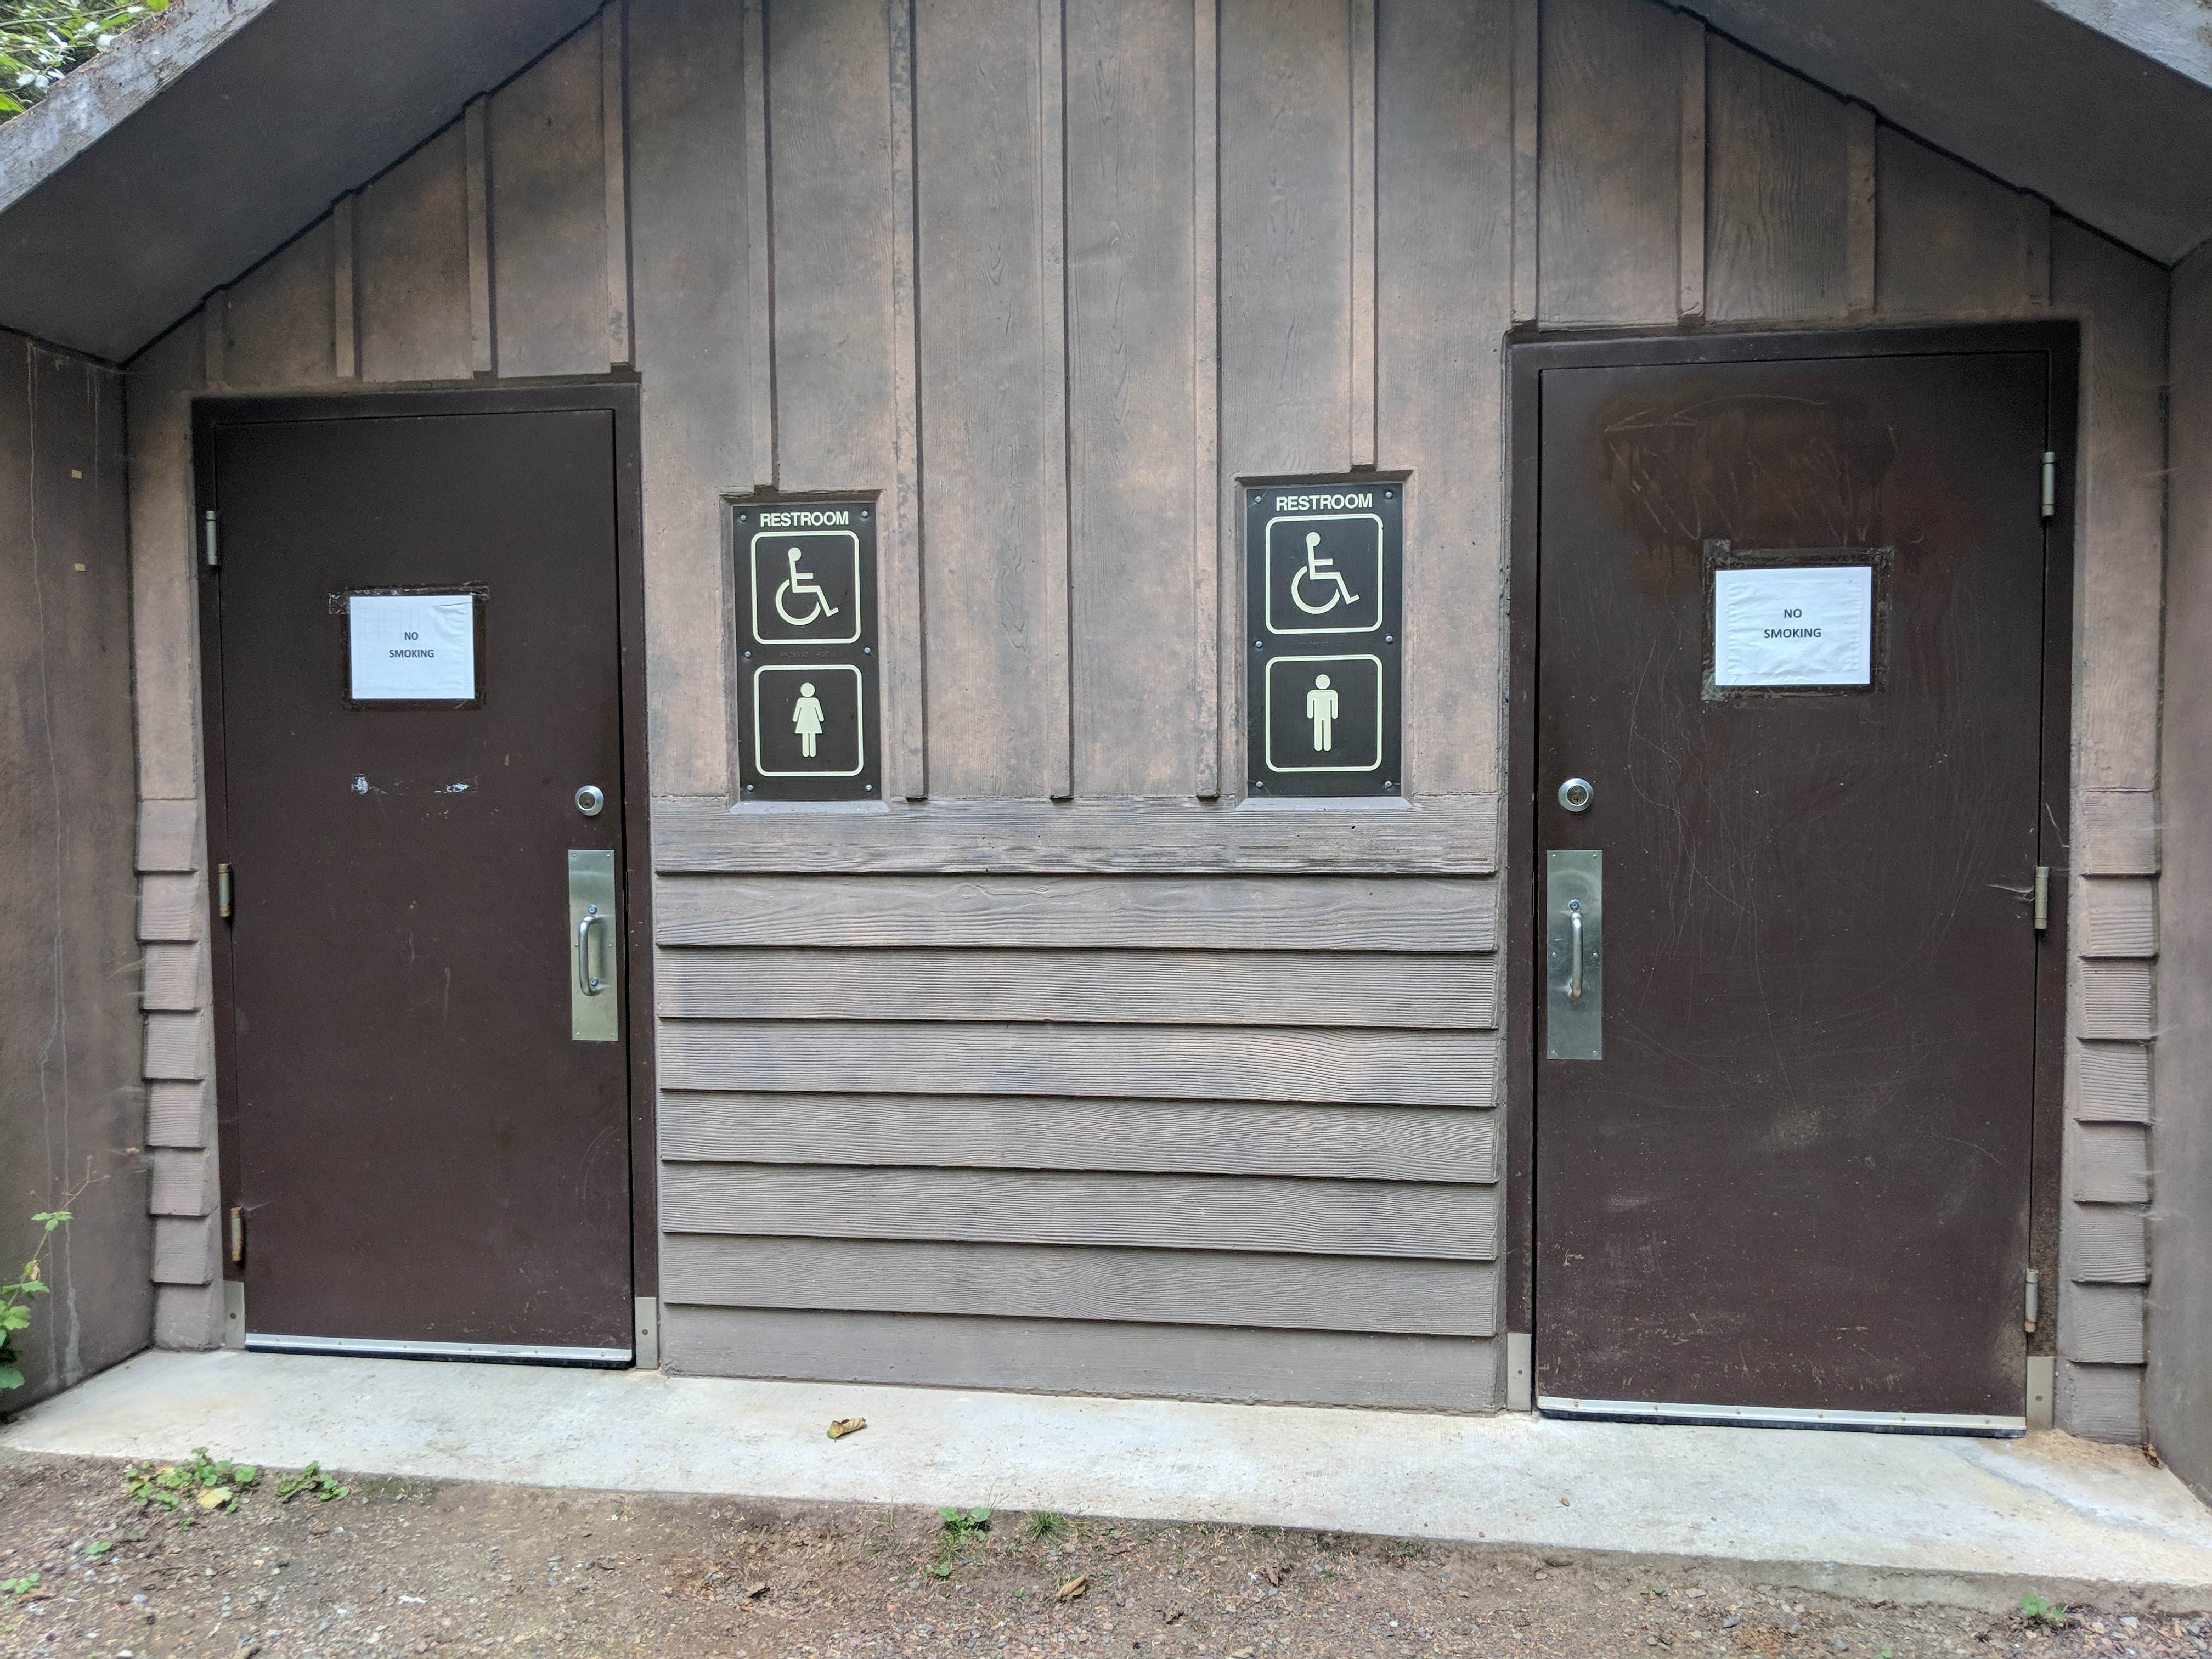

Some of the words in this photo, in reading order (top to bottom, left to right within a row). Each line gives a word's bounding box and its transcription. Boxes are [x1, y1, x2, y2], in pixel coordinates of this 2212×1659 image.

[1276, 493, 1372, 511] RESTROOM
[760, 511, 849, 527] RESTROOM
[1784, 608, 1802, 618] NO
[404, 631, 419, 641] NO
[1764, 628, 1822, 639] SMOKING
[389, 649, 435, 658] SMOKING
